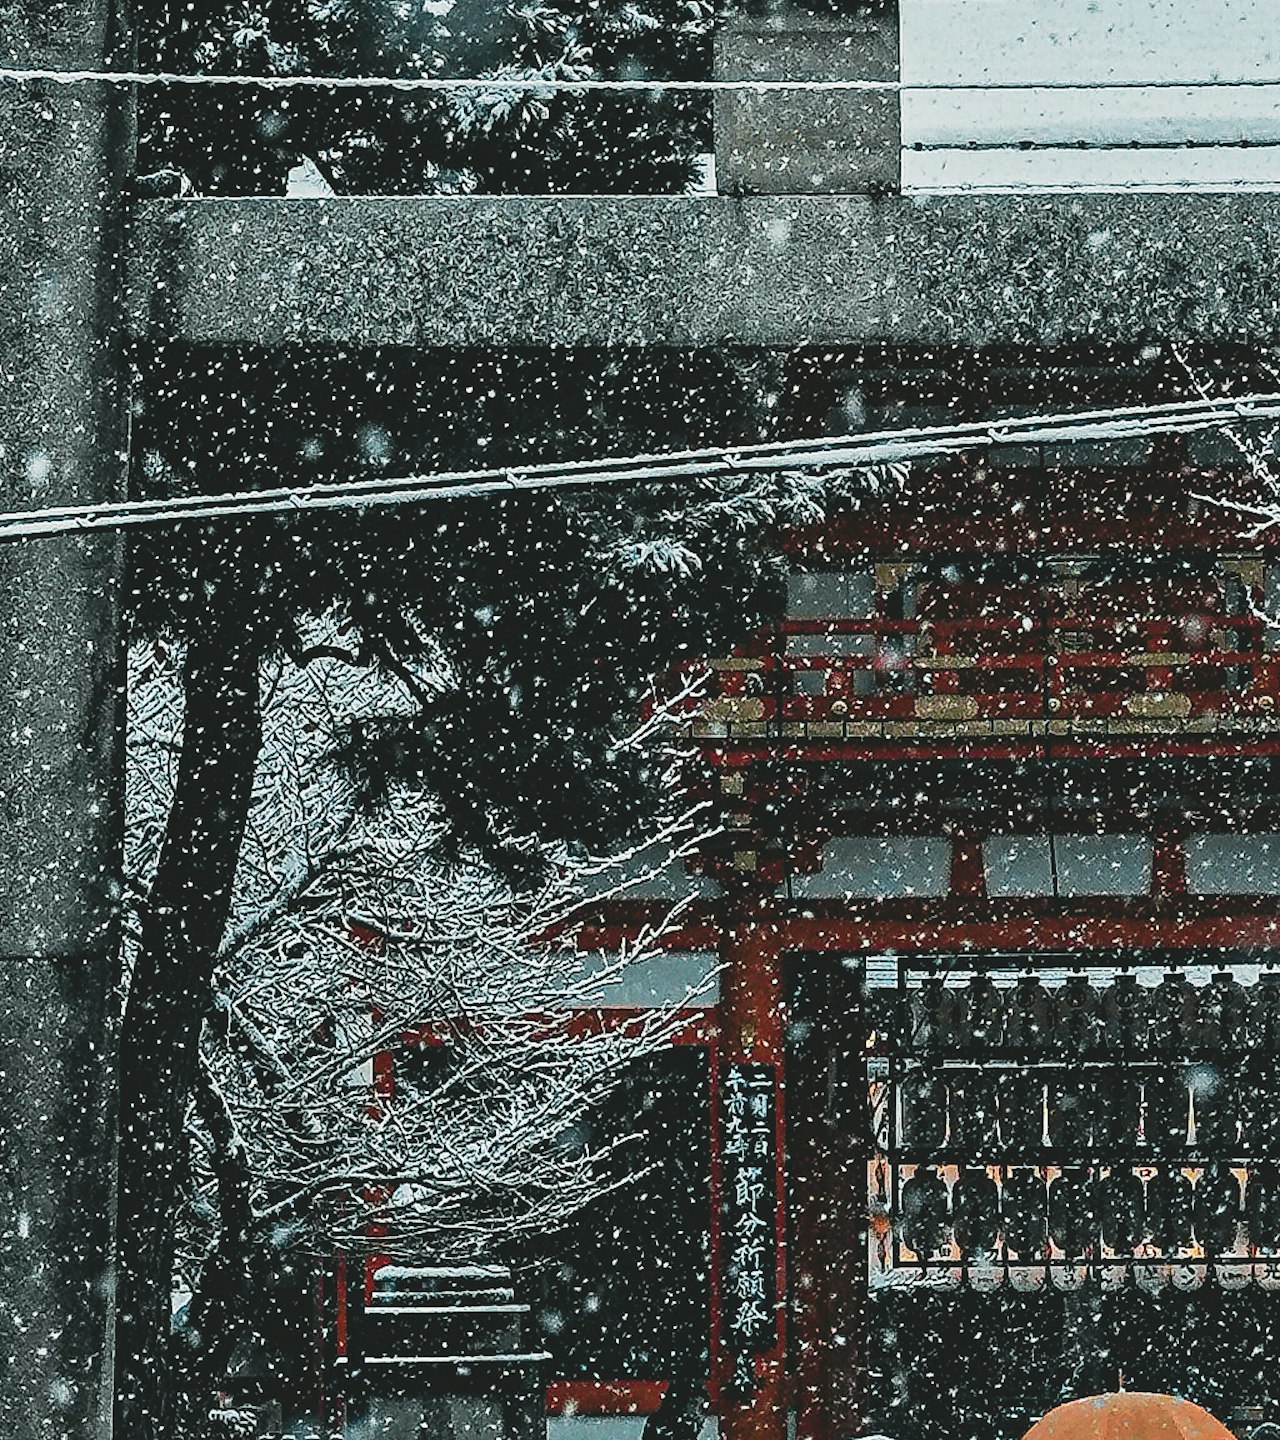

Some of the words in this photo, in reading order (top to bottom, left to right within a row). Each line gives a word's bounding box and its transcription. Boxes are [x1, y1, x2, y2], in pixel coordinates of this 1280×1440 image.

[722, 1066, 749, 1163] 午前九時
[749, 1072, 773, 1156] 二月二日
[730, 1166, 768, 1337] 節分祈願祭
